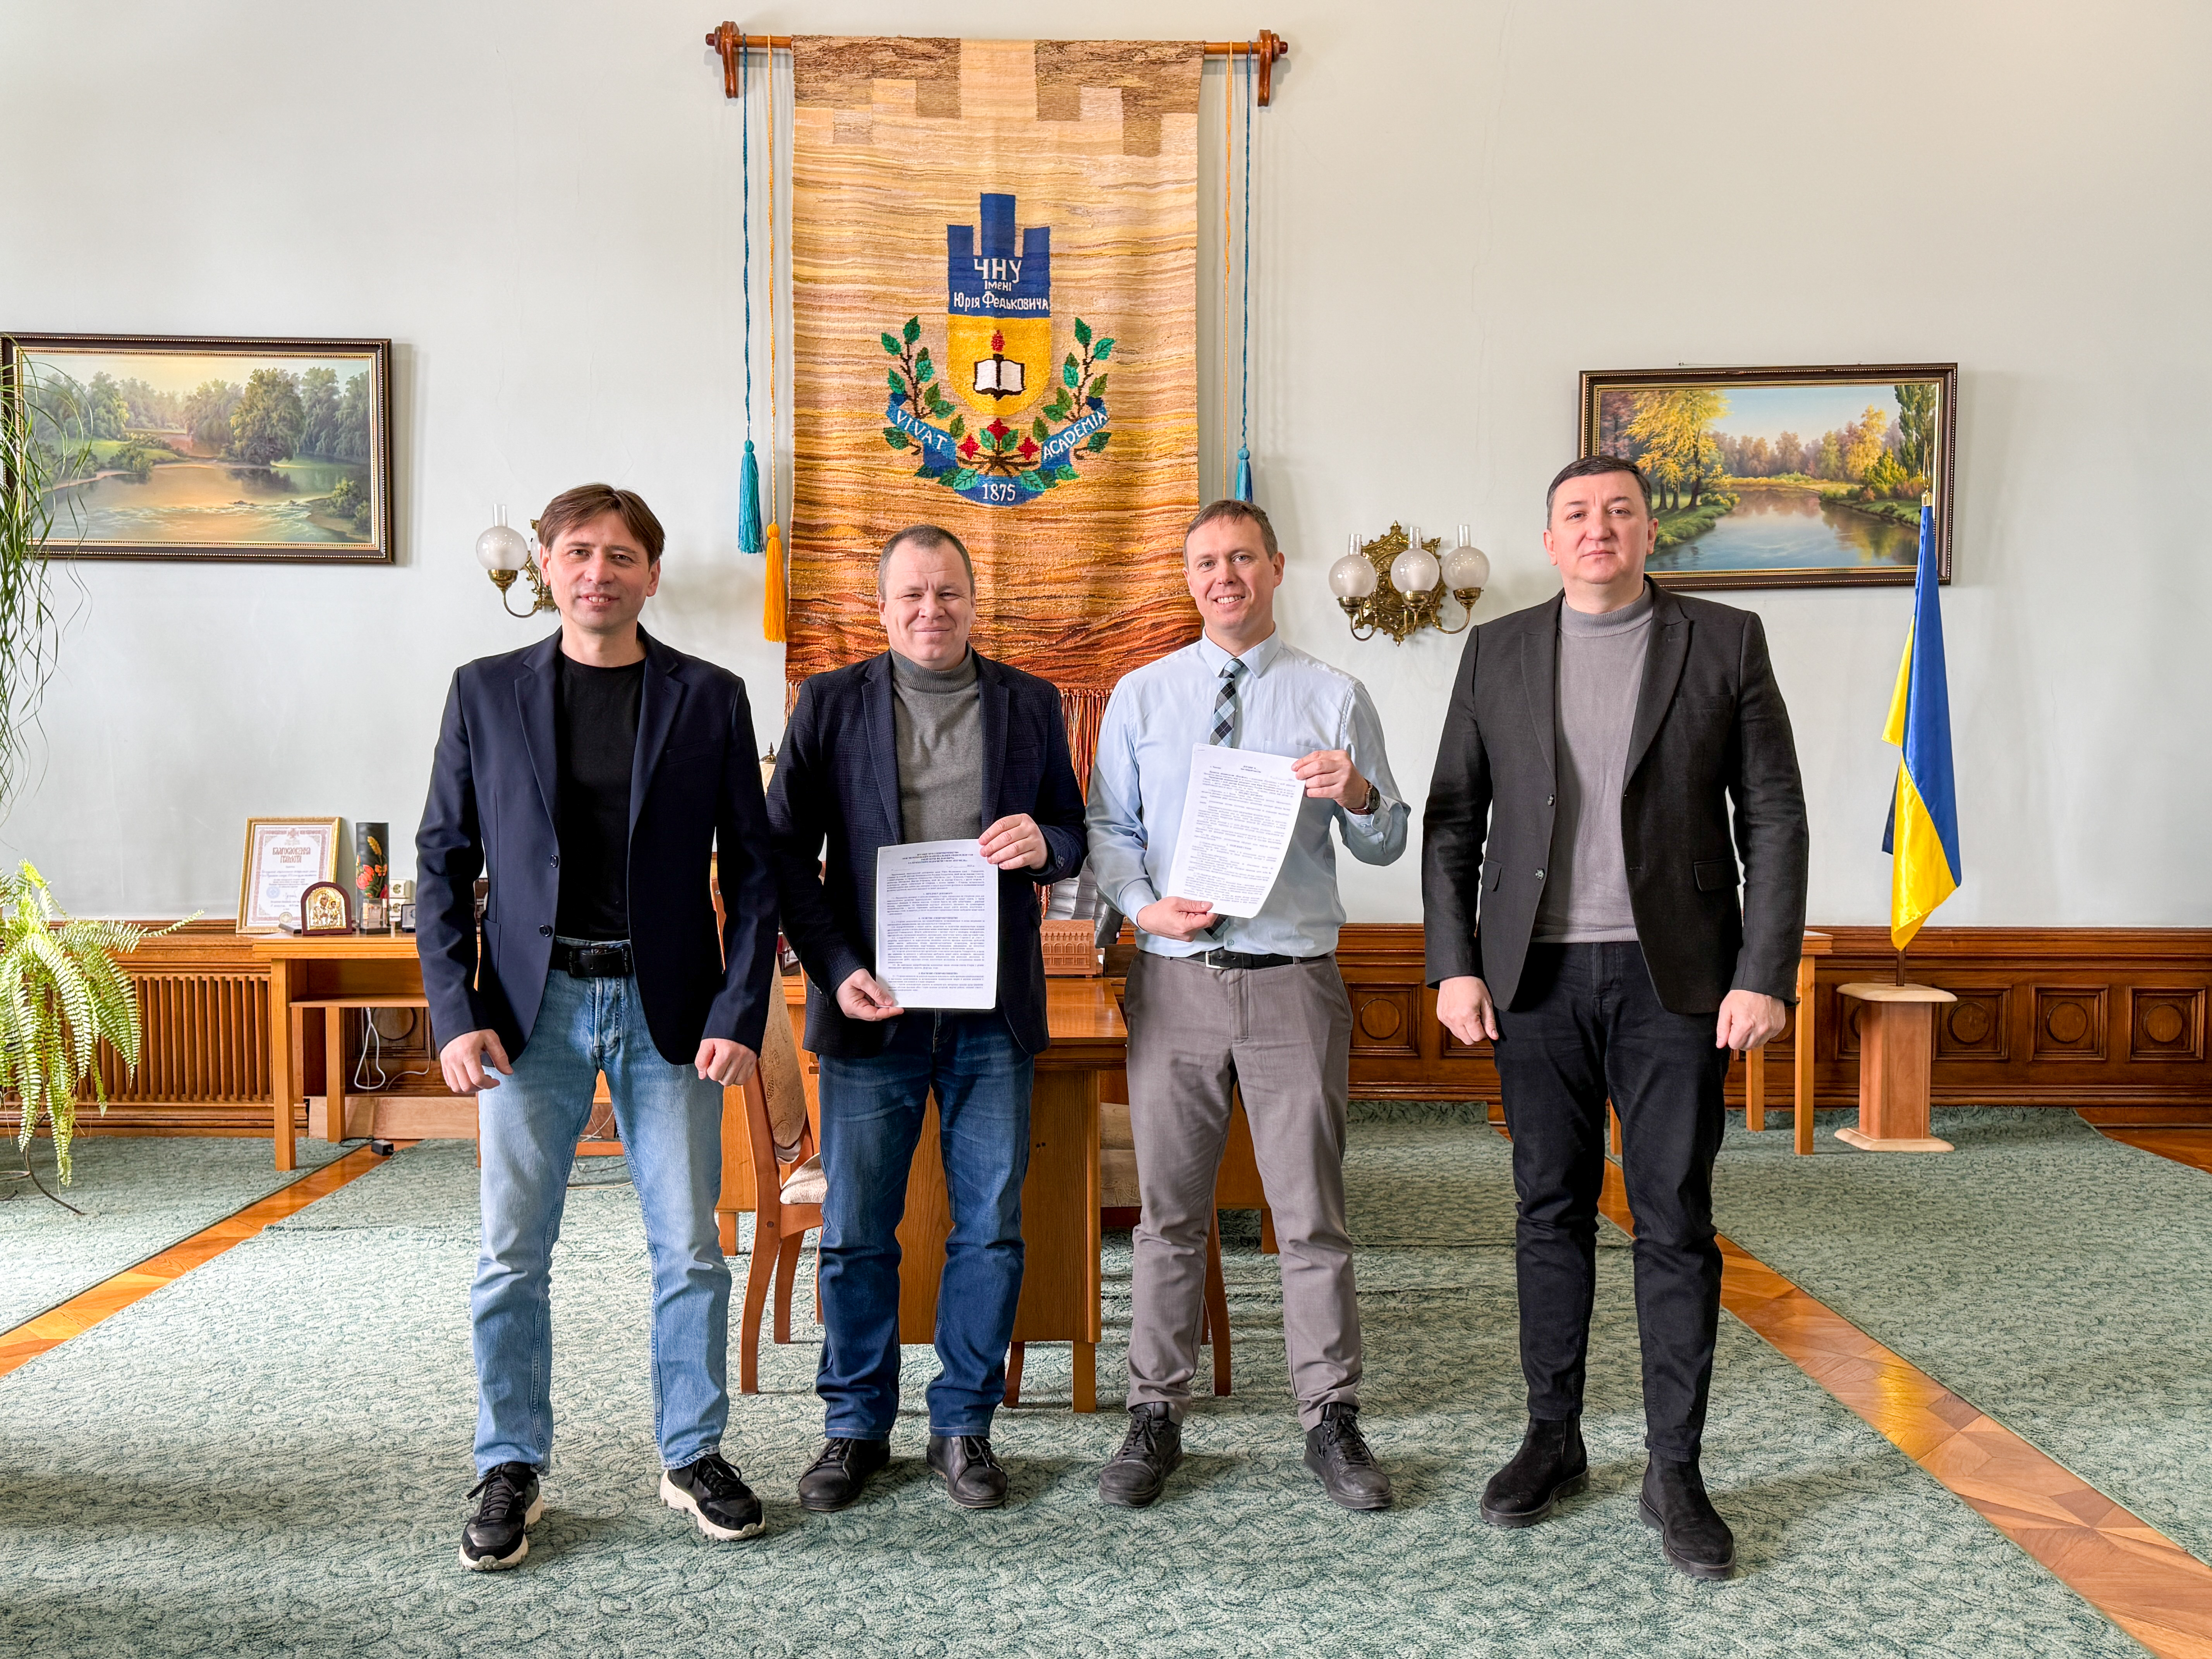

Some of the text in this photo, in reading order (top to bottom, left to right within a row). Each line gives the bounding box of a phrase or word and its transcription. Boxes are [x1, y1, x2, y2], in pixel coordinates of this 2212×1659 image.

[974, 258, 1022, 283] ЧНУ
[954, 291, 1049, 312] Юрія Федьковича
[897, 410, 1108, 459] VIVAT ACADEMIA
[982, 483, 1015, 501] 1875
